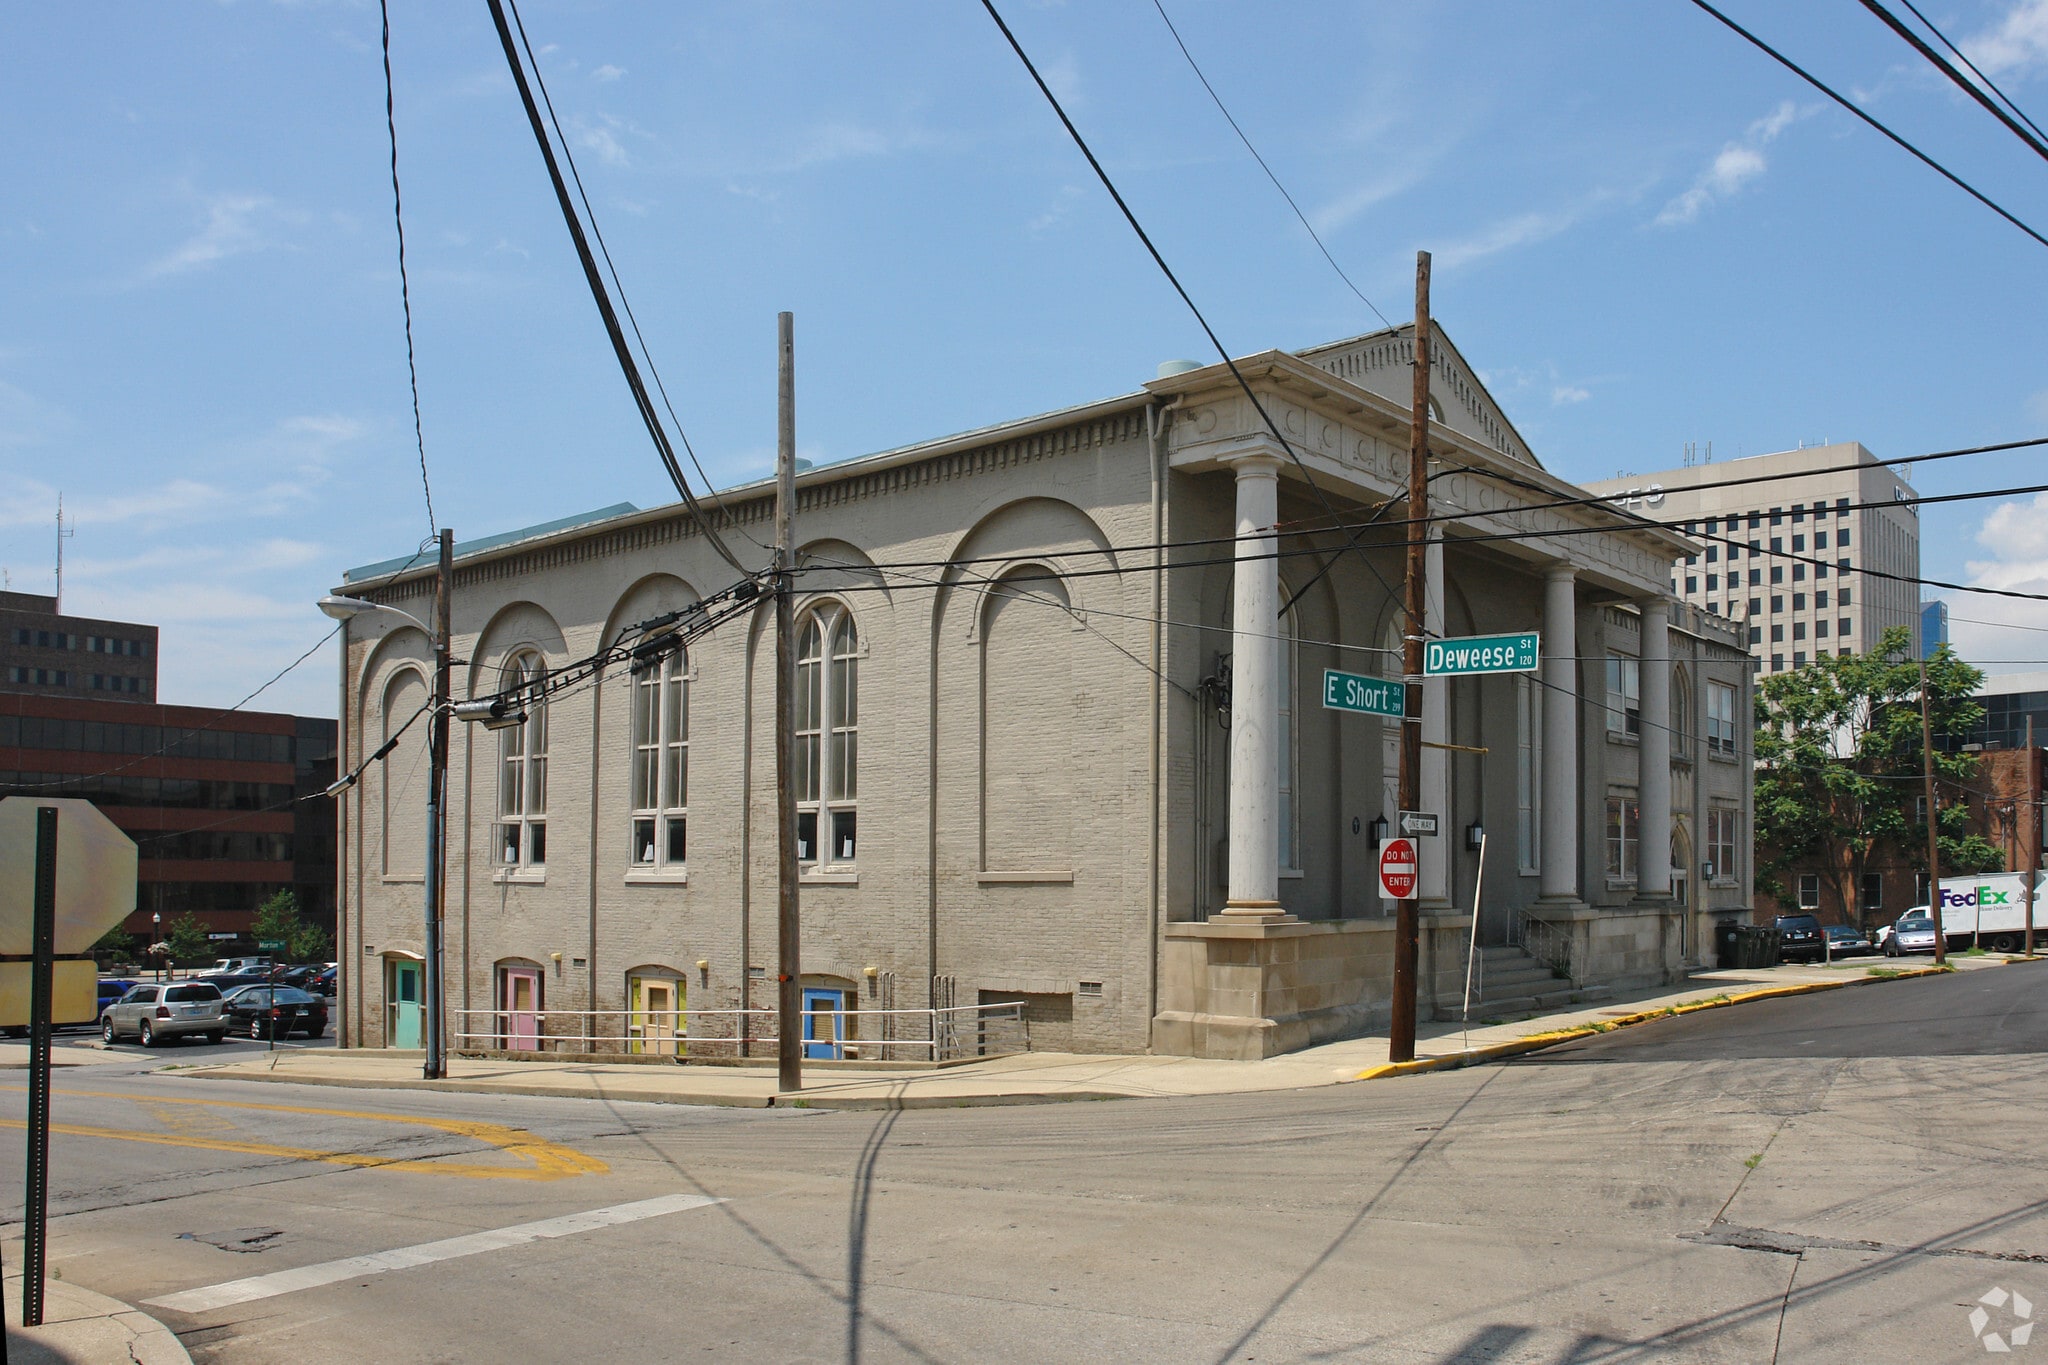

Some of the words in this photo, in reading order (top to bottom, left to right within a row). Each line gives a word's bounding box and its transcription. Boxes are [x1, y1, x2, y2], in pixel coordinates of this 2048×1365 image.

[1430, 645, 1515, 671] Deweese
[1520, 639, 1532, 649] St
[1520, 655, 1533, 665] 120
[1328, 675, 1339, 703] E
[1346, 679, 1388, 710] Short
[1393, 686, 1401, 697] St
[1392, 702, 1401, 712] 299
[1408, 819, 1420, 829] ONE
[1421, 820, 1433, 830] WAY
[1386, 851, 1398, 860] DO
[1401, 851, 1413, 860] NOT
[1389, 877, 1411, 886] ENTER
[1939, 886, 2009, 908] FedEx
